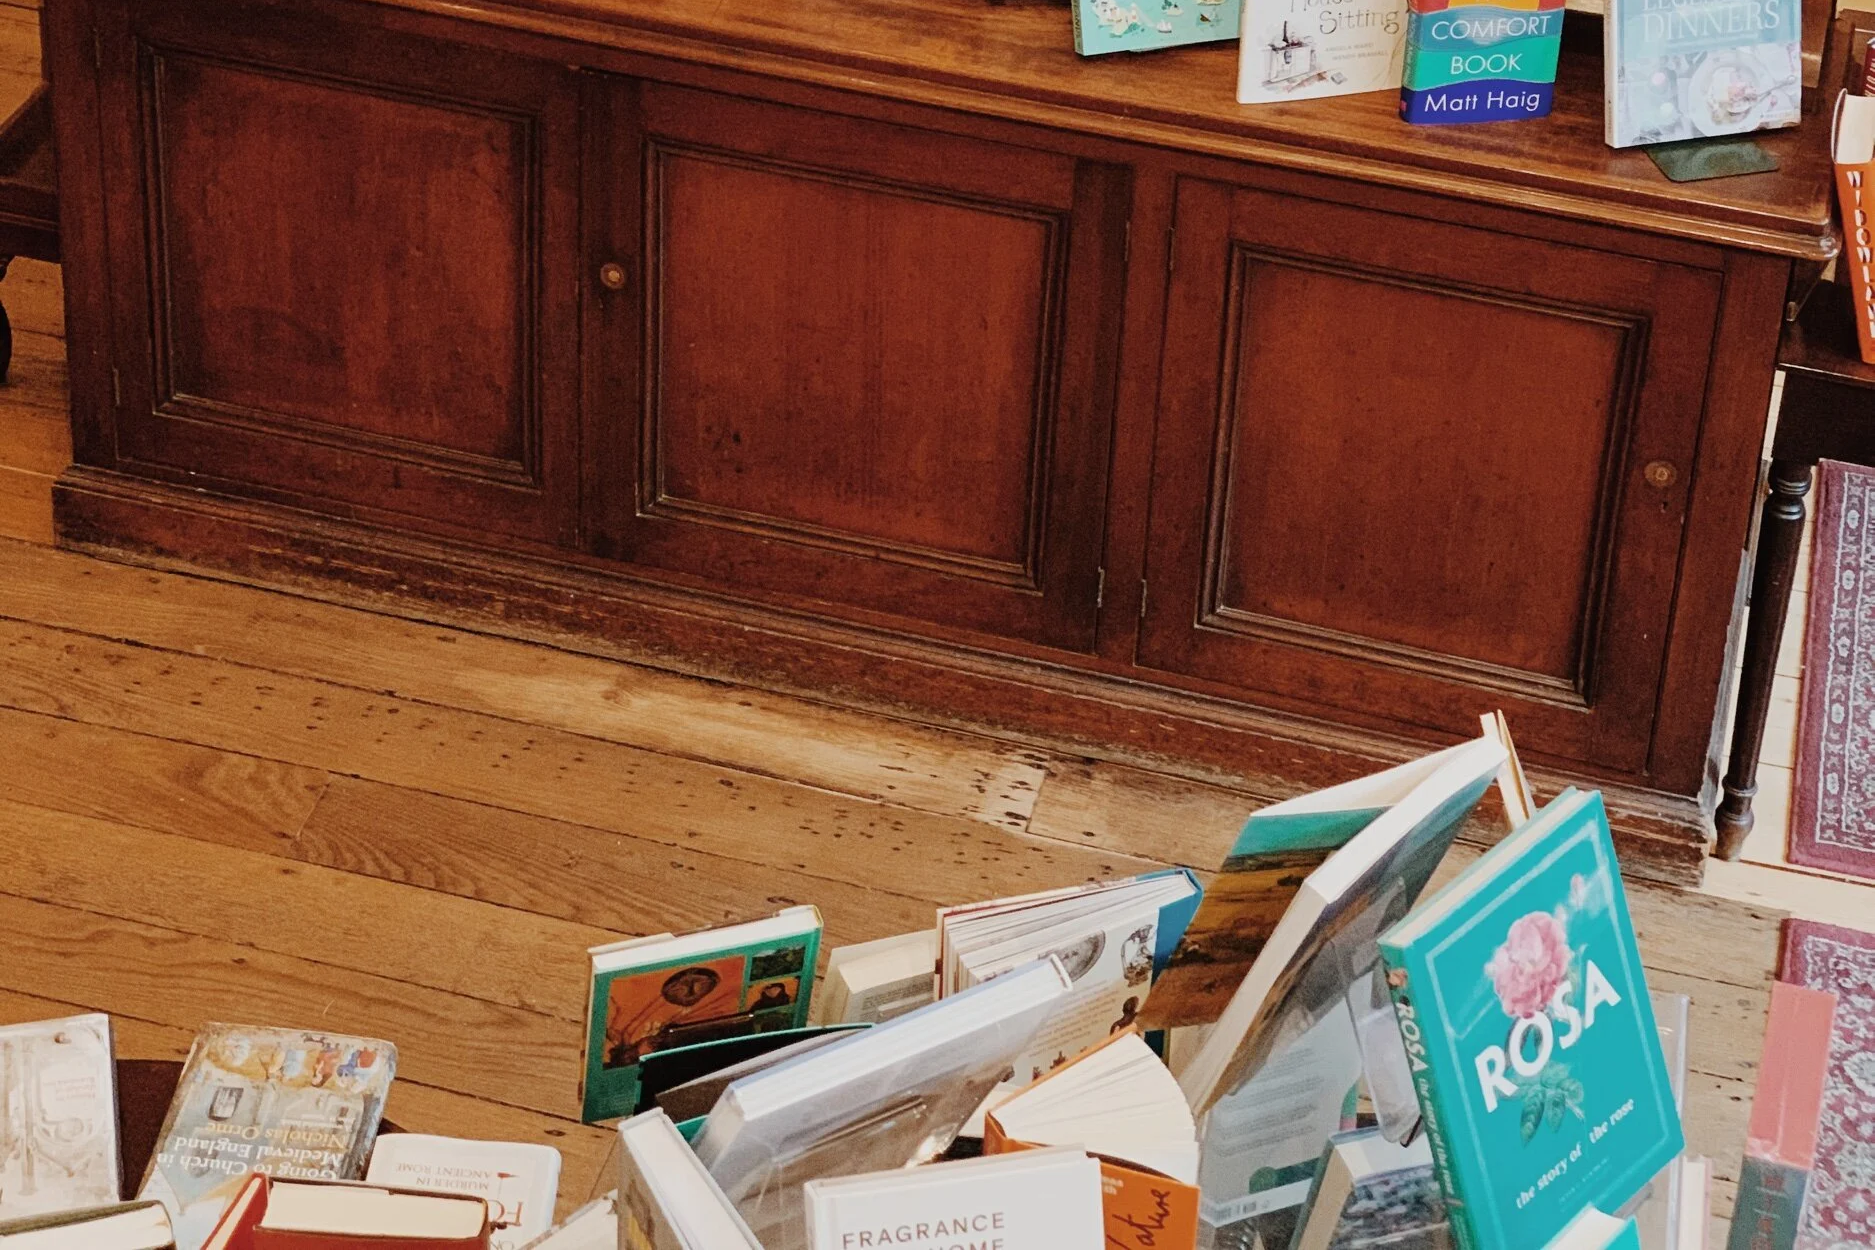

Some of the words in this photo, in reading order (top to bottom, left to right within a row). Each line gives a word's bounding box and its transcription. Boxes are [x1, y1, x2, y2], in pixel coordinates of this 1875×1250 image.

[1318, 8, 1401, 35] Sitting
[1431, 15, 1552, 42] COMFORT
[1641, 0, 1781, 43] DINNERS
[1449, 52, 1522, 75] BOOK
[1424, 92, 1482, 113] Matt
[1486, 90, 1541, 111] Haig
[1396, 1001, 1430, 1073] ROSA
[1473, 958, 1622, 1114] ROSA
[207, 1122, 260, 1140] Orme
[265, 1127, 347, 1148] Nicholas
[175, 1136, 253, 1155] England
[256, 1145, 344, 1166] Medieval
[1515, 1185, 1536, 1209] the
[1536, 1157, 1569, 1193] story
[1568, 1140, 1584, 1164] of
[1588, 1118, 1609, 1145] the
[1609, 1098, 1635, 1131] rose
[180, 1153, 248, 1176] Church
[841, 1211, 1006, 1250] FRAGRANCE
